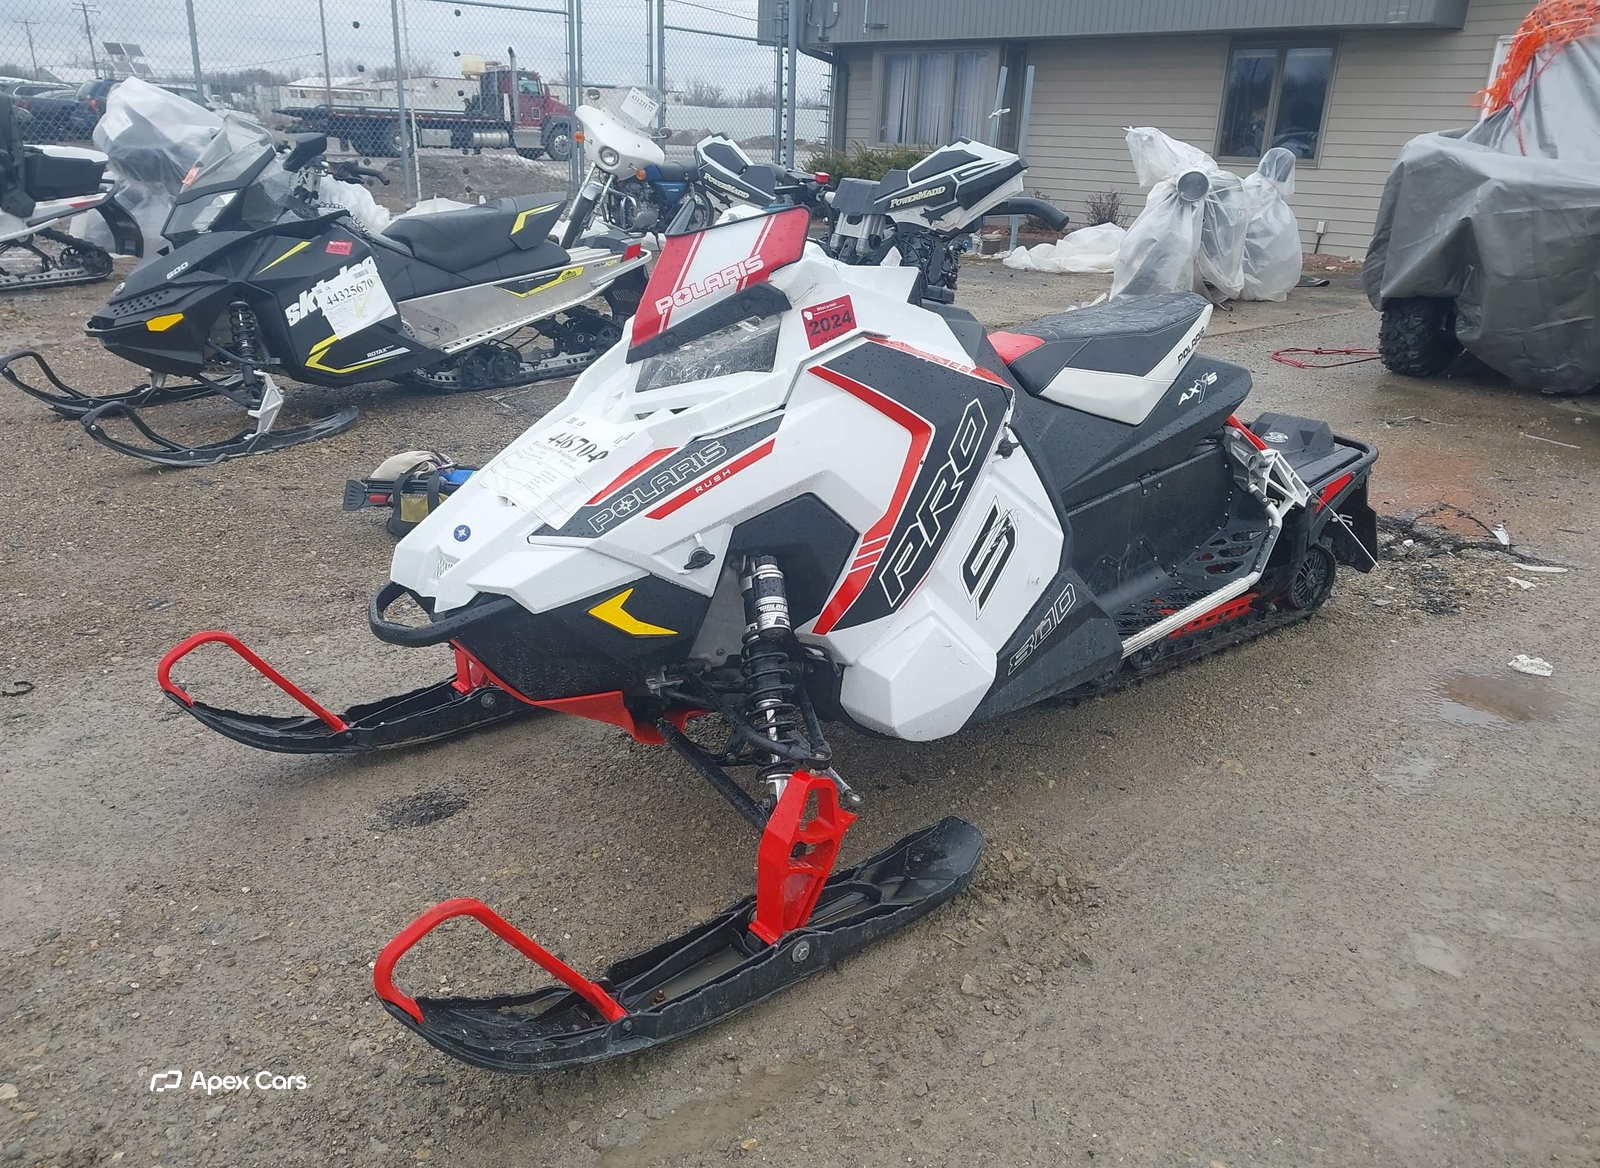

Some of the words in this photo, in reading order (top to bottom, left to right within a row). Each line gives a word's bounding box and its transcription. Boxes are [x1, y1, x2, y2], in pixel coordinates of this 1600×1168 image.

[166, 261, 188, 280] 600
[655, 254, 764, 316] POLARIS
[326, 278, 374, 306] 44325670
[808, 309, 852, 337] 2024
[1178, 326, 1205, 364] POLARIS
[1178, 372, 1218, 406] AXYS
[587, 440, 727, 533] POLARIS
[695, 468, 732, 494] RUSH
[879, 398, 988, 608] PRO
[1008, 583, 1077, 676] 800
